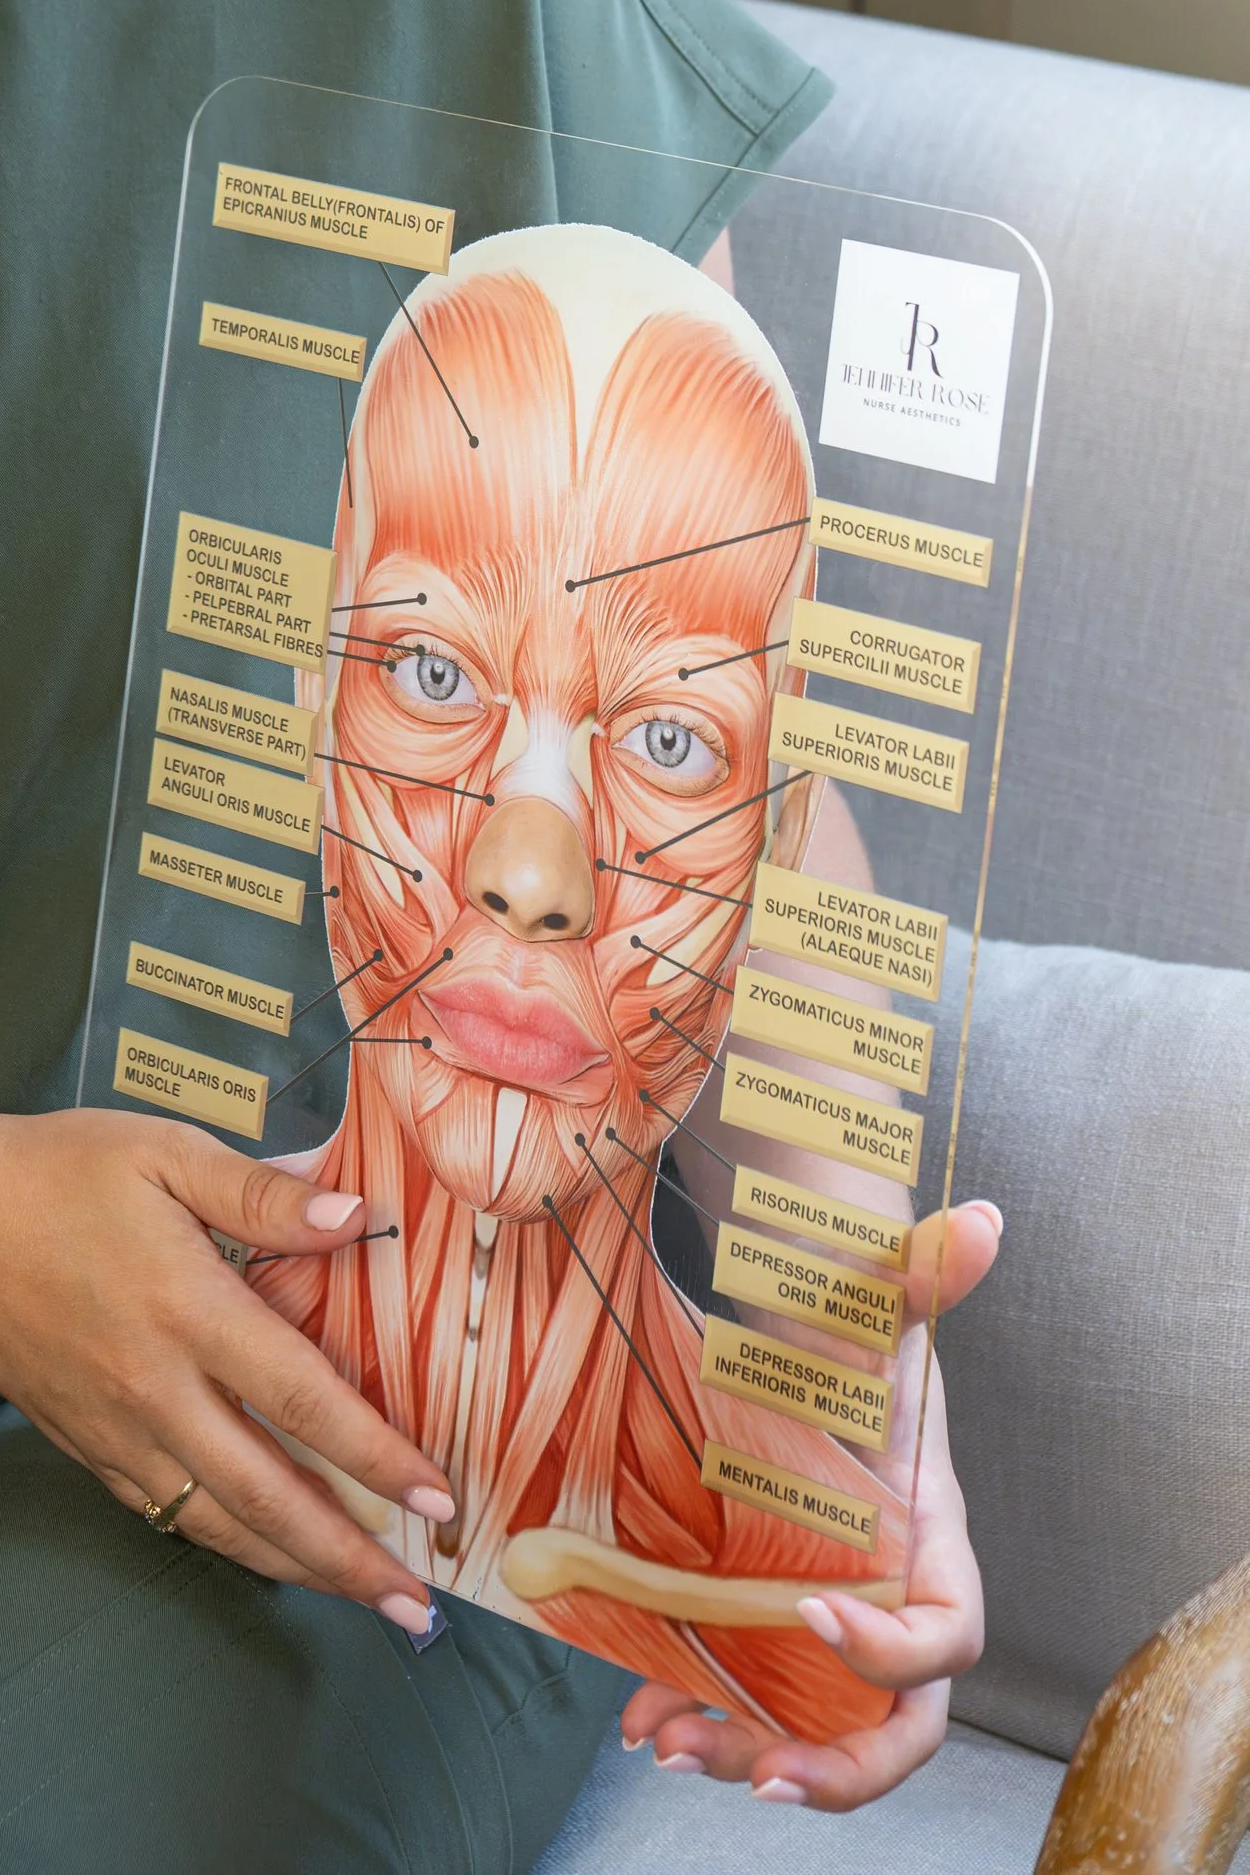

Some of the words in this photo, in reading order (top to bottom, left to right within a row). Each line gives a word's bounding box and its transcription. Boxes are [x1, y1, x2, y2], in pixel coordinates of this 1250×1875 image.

[223, 196, 307, 226] EPICRANIUS
[310, 215, 368, 239] MUSCLE
[225, 177, 288, 202] FRONTAL
[291, 190, 421, 233] BELLY(FRONTALIS)
[425, 218, 445, 234] OF
[212, 318, 299, 350] TEMPORALIS
[302, 339, 360, 364] MUSCLE
[863, 397, 896, 413] NURSE
[900, 406, 962, 427] AESTHETICS
[931, 384, 992, 415] ROSE
[187, 549, 229, 571] OCULI
[232, 560, 289, 587] MUSCLE
[189, 529, 282, 565] ORBICULARIS
[820, 515, 910, 550] PROCERUS
[915, 538, 983, 568] MUSCLE
[193, 590, 272, 624] PELPEBRAL
[276, 613, 312, 634] PART
[195, 571, 253, 598] ORBITAL
[257, 587, 292, 608] PART
[191, 610, 270, 644] PRETARSAL
[274, 633, 324, 658] FIBRES
[850, 630, 965, 673] CORRUGATOR
[799, 639, 889, 675] SUPERCILII
[894, 663, 962, 694] MUSCLE
[168, 707, 264, 746] (TRANSVERSE
[267, 735, 306, 761] PART)
[170, 687, 228, 715] NASALIS
[232, 704, 289, 733] MUSCLE
[164, 757, 225, 787] LEVATOR
[782, 731, 880, 771] SUPERIORIS
[884, 760, 953, 792] MUSCLE
[835, 723, 908, 757] LEVATOR
[913, 745, 955, 770] LABII
[161, 777, 214, 804] ANGULI
[217, 793, 250, 814] ORIS
[253, 803, 311, 833] MUSCLE
[150, 850, 223, 885] MASSETER
[226, 874, 283, 904] MUSCLE
[765, 898, 862, 940] SUPERIORIS
[867, 929, 935, 963] MUSCLE
[818, 891, 891, 927] LEVATOR
[895, 915, 937, 941] LABII
[801, 932, 884, 970] (ALAEQUE
[888, 958, 932, 987] NASI)
[135, 958, 224, 1000] BUCCINATOR
[227, 988, 285, 1020] MUSCLE
[749, 984, 865, 1033] ZYGOMATICUS
[869, 1022, 924, 1053] MINOR
[125, 1066, 181, 1097] MUSCLE
[127, 1047, 220, 1090] ORBICULARIS
[223, 1080, 256, 1102] ORIS
[853, 1040, 921, 1075] MUSCLE
[735, 1071, 851, 1122] ZYGOMATICUS
[855, 1111, 913, 1144] MAJOR
[843, 1129, 911, 1166] MUSCLE
[751, 1187, 827, 1226] RISORIUS
[832, 1215, 900, 1253] MUSCLE
[730, 1241, 828, 1290] DEPRESSOR
[832, 1279, 895, 1314] ANGULI
[778, 1282, 817, 1308] ORIS
[825, 1298, 893, 1337] MUSCLE
[715, 1356, 806, 1403] INFERIORIS
[814, 1393, 882, 1433] MUSCLE
[740, 1342, 838, 1393] DEPRESSOR
[842, 1381, 884, 1411] LABII
[719, 1461, 798, 1505] MENTALIS
[803, 1494, 871, 1535] MUSCLE
